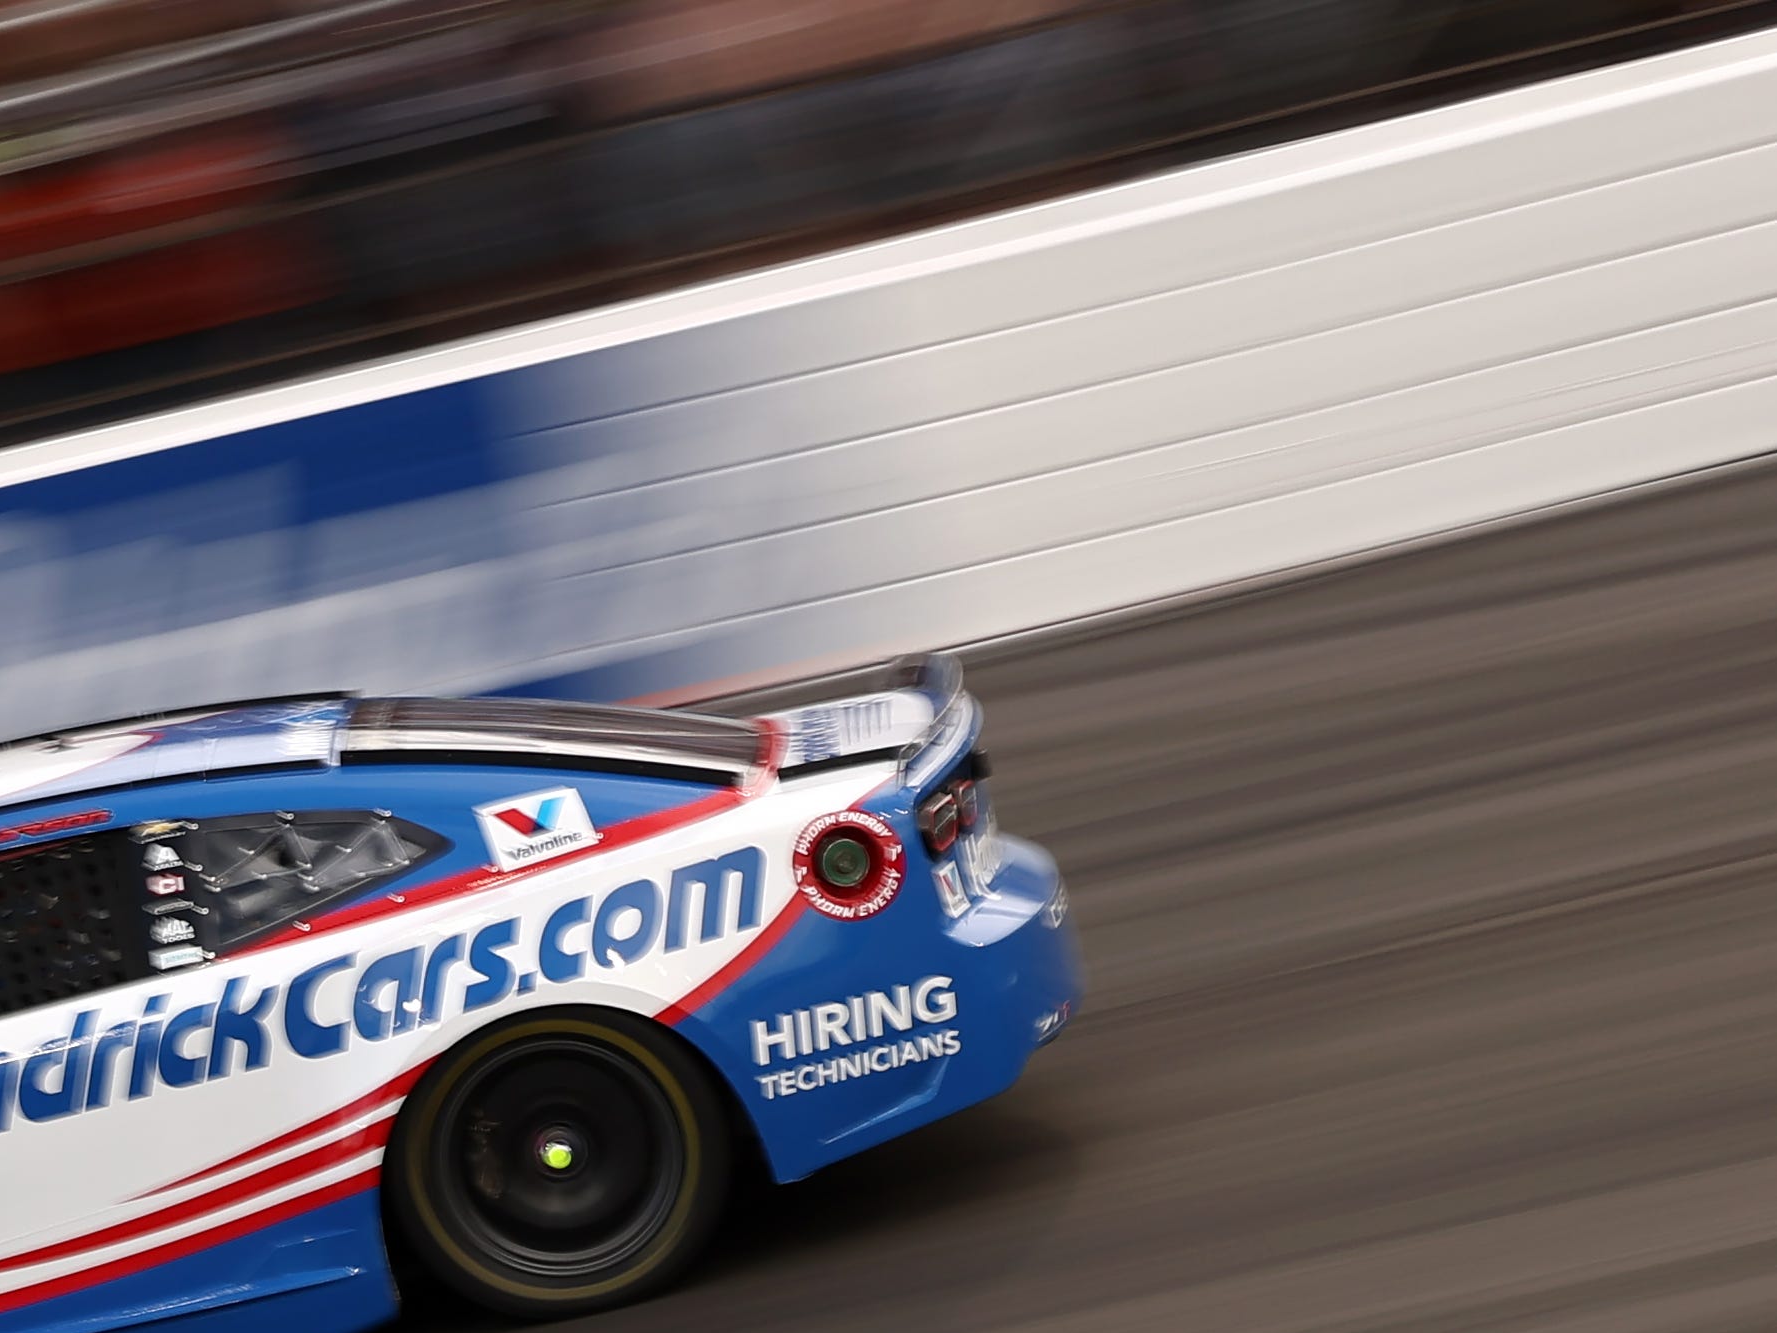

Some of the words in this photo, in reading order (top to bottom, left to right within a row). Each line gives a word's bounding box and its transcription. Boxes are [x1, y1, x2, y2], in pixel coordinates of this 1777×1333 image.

[505, 832, 583, 861] Valvoline
[749, 974, 957, 1067] HIRING
[754, 1028, 962, 1100] TECHNICIANS
